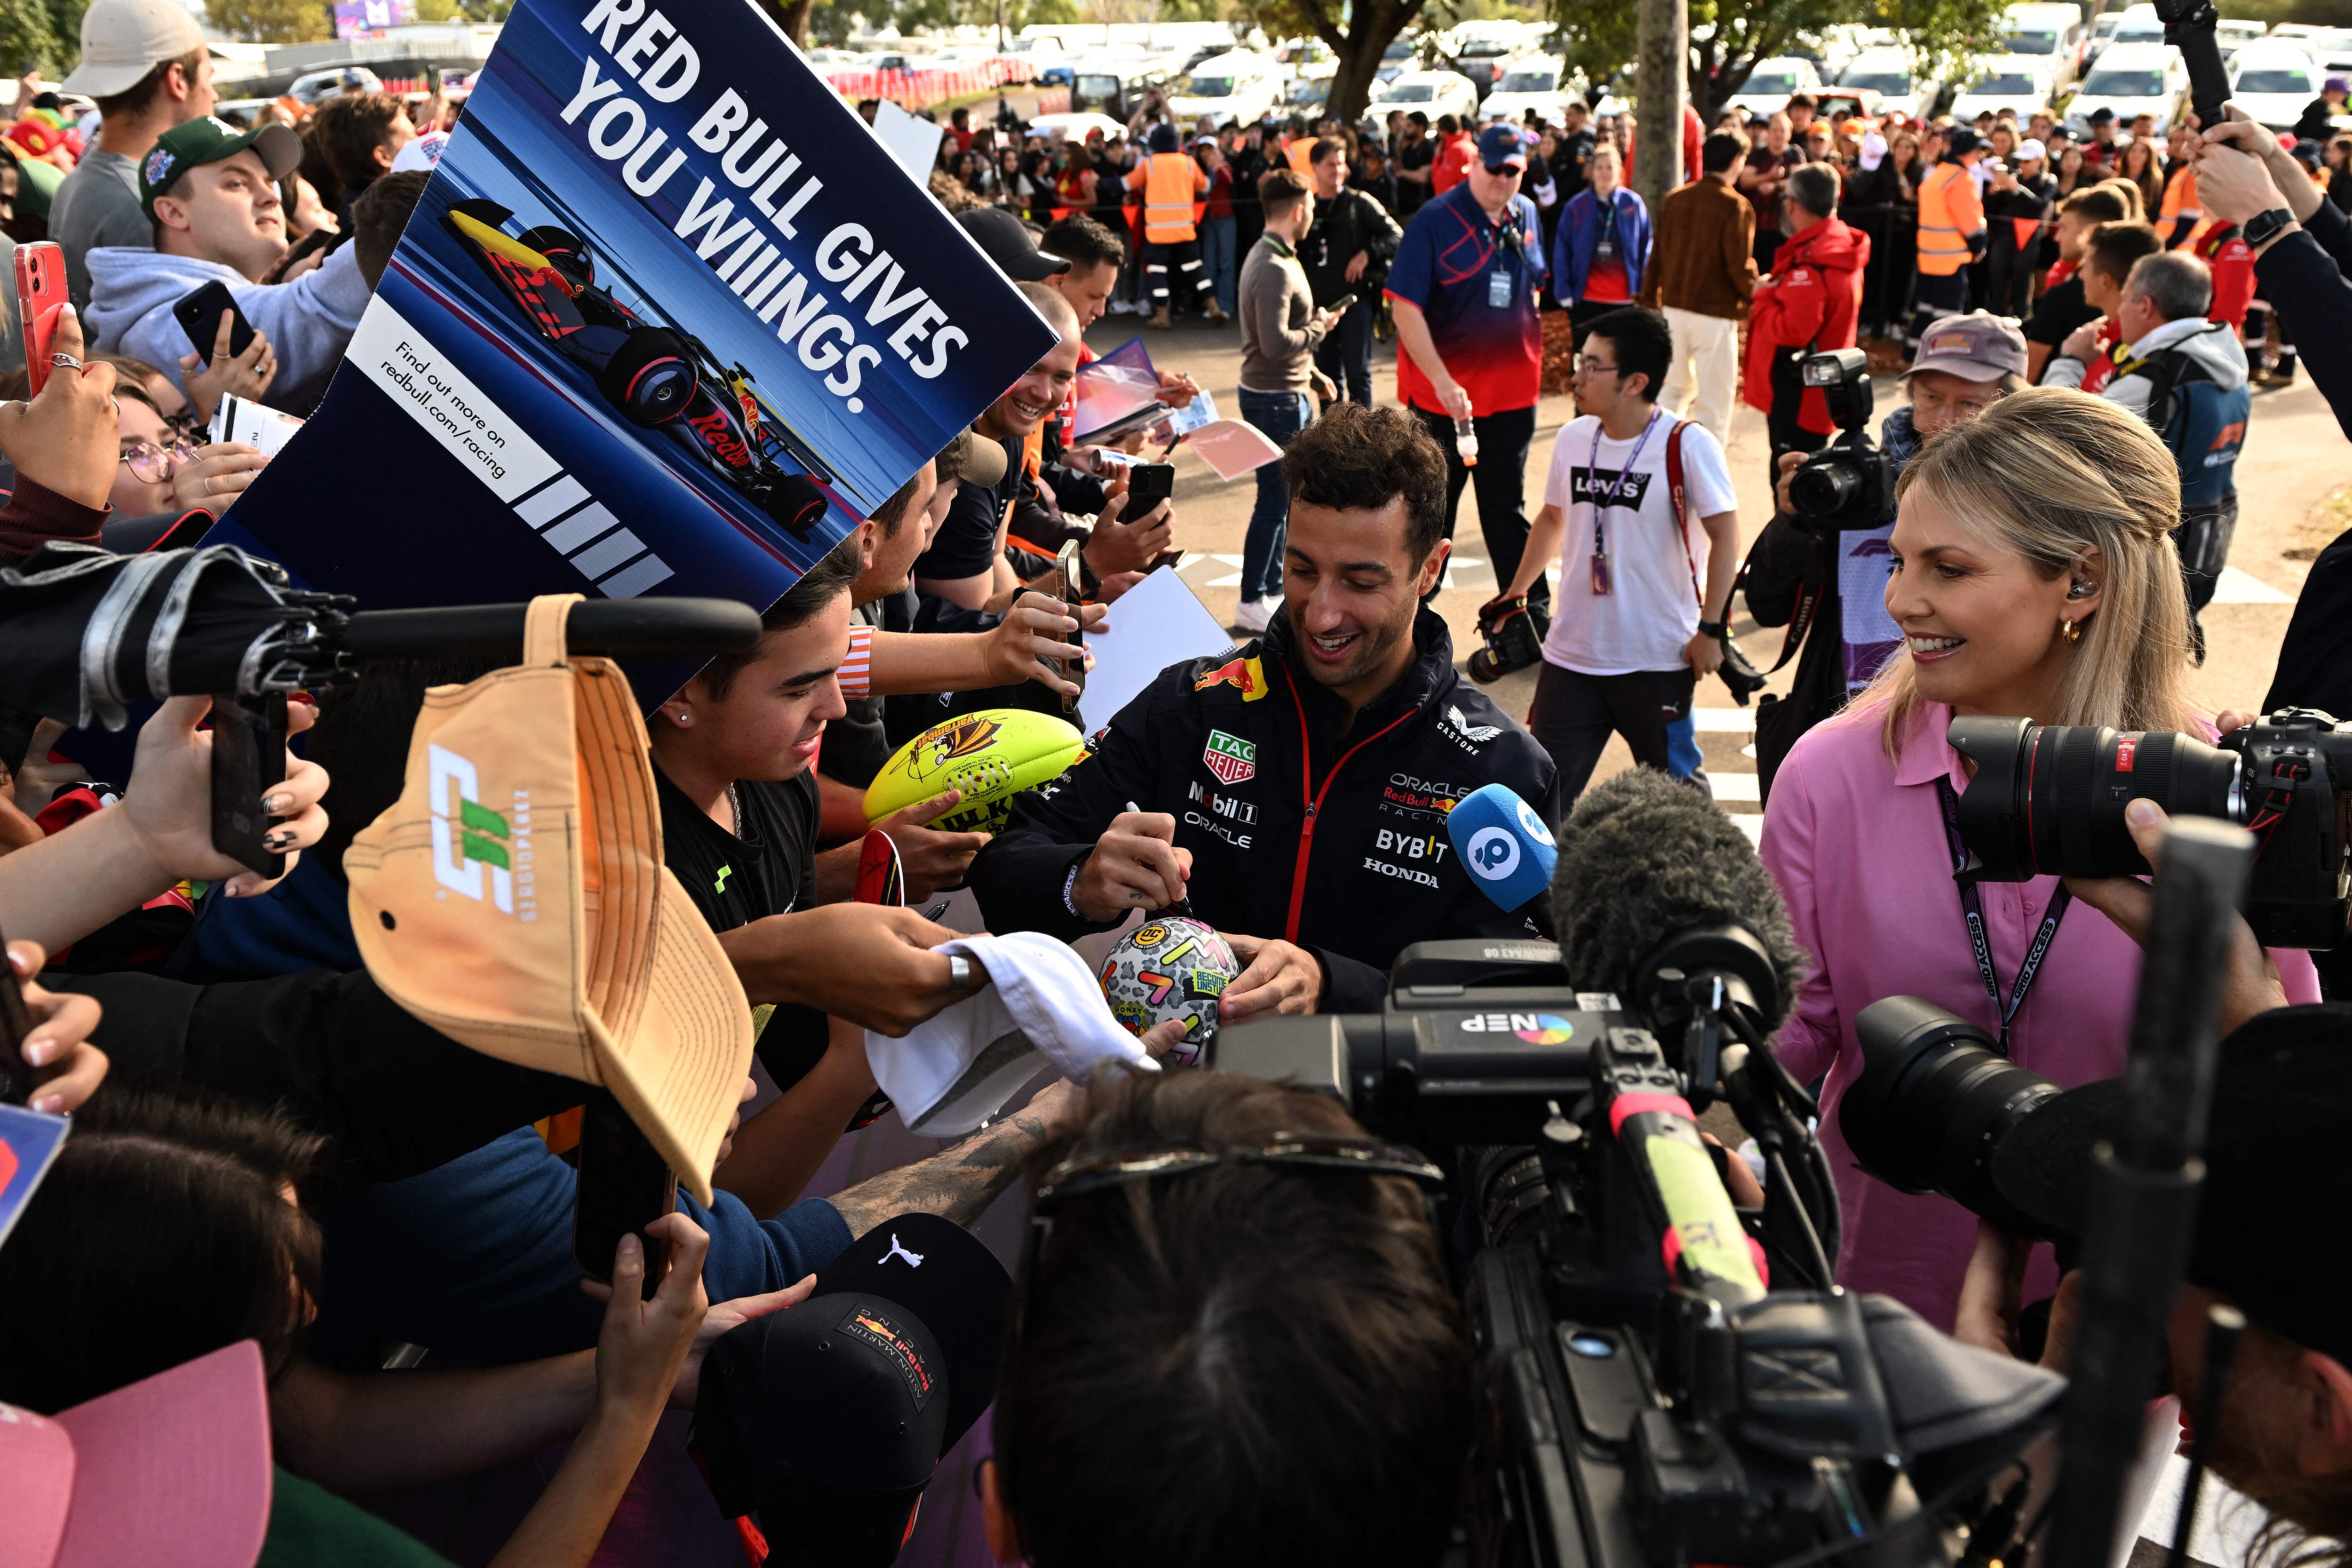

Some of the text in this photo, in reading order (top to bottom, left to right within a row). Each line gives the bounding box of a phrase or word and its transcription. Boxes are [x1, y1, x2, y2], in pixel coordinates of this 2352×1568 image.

[581, 0, 969, 379] RED BULL GIVES
[559, 55, 882, 414] YOU WIIINGS.
[395, 341, 505, 448] Find out more on
[381, 361, 506, 479] redbull.com/racing
[916, 714, 977, 749] yarrambat
[1216, 734, 1253, 760] TAG
[1437, 722, 1479, 756] CASTORE
[959, 764, 977, 773] FAULKNER
[1207, 752, 1253, 780] HEUER
[980, 785, 998, 795] FAULKNER
[1189, 781, 1253, 821] Mobil 1
[1390, 773, 1470, 798] ORACLE
[1184, 812, 1252, 849] ORACLE
[1379, 804, 1446, 825] RACIN
[1376, 829, 1448, 863] BYBIT
[1064, 865, 1078, 916] ENCHANTE
[1363, 858, 1438, 888] HONDA
[1968, 916, 1996, 997] GRID ACCESS
[2015, 920, 2055, 999] GRID ACCESS
[1197, 971, 1226, 987] BECOME
[1461, 1014, 1539, 1032] NEP
[847, 1325, 922, 1397] ASTON MARTIN
[860, 1309, 933, 1384] RACING
